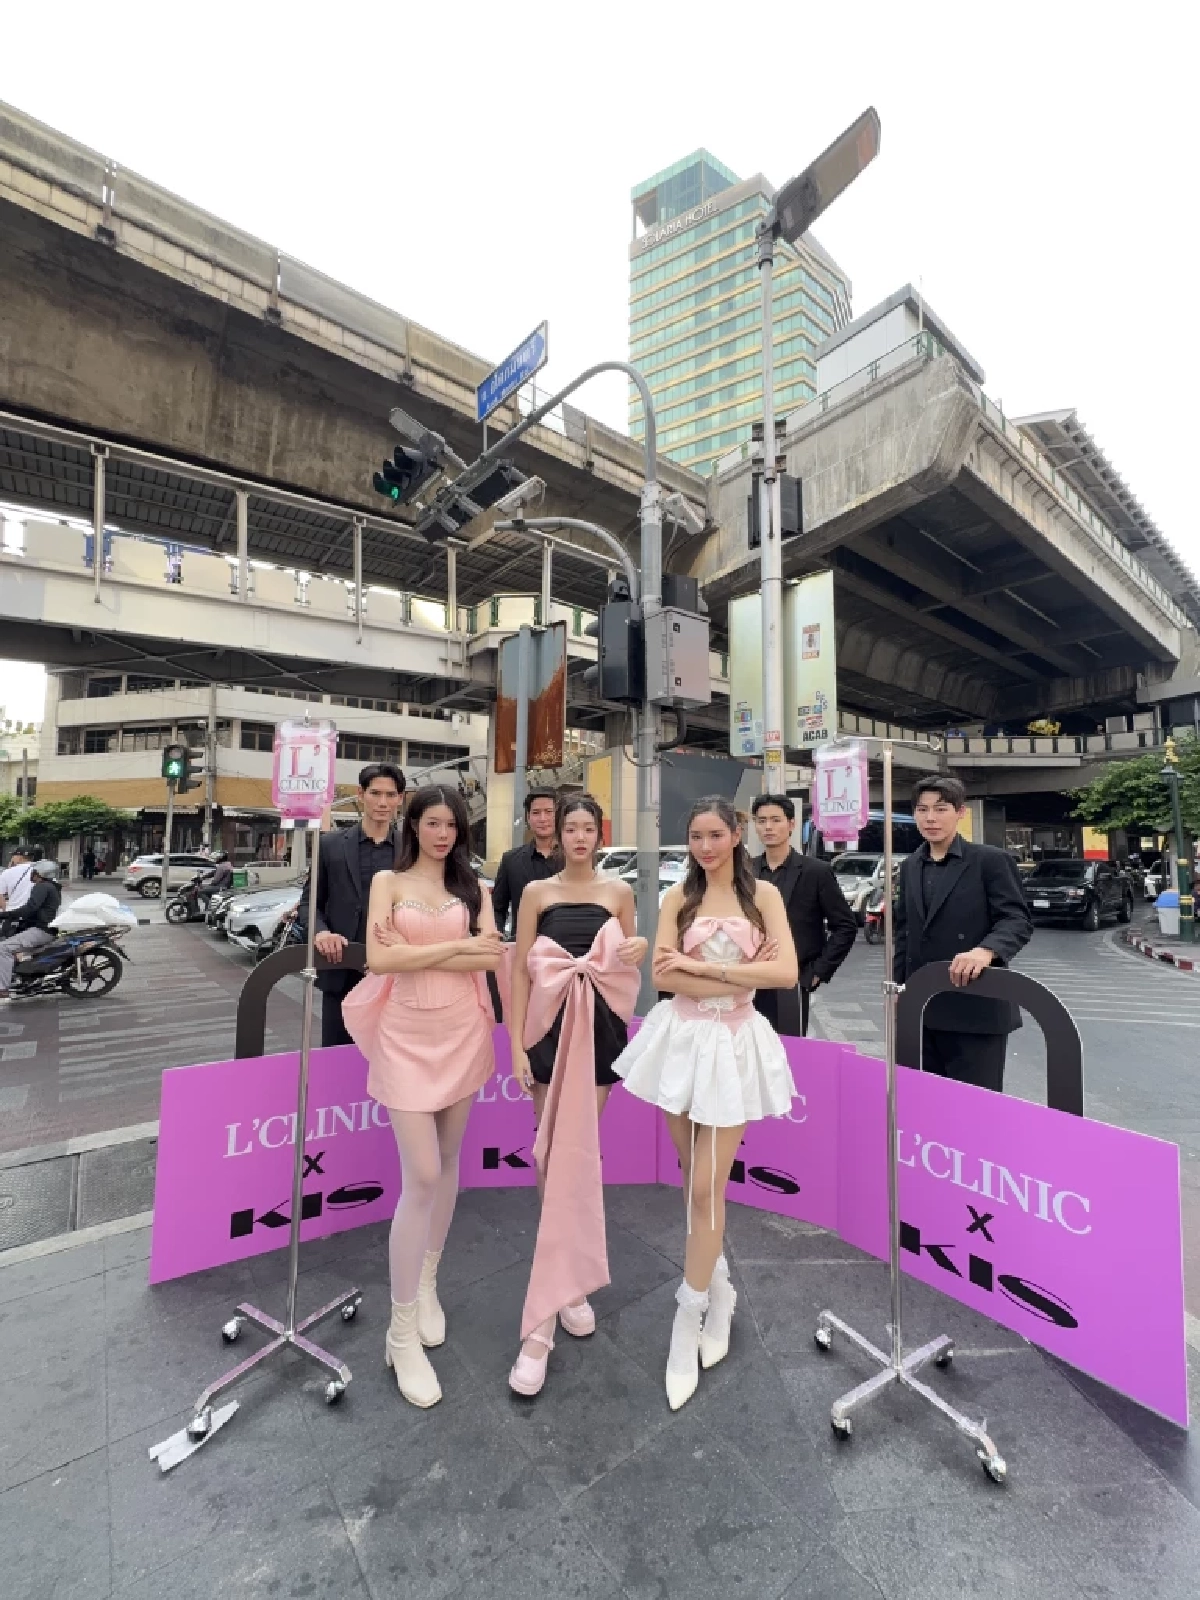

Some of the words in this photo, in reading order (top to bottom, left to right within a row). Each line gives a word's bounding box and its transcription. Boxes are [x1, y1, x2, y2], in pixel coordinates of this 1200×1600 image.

[641, 219, 683, 250] SOLARIA
[685, 199, 718, 227] HOTEL
[802, 729, 828, 741] ACAB
[280, 779, 326, 791] CLINIC
[897, 1129, 1092, 1235] L'CLINIC
